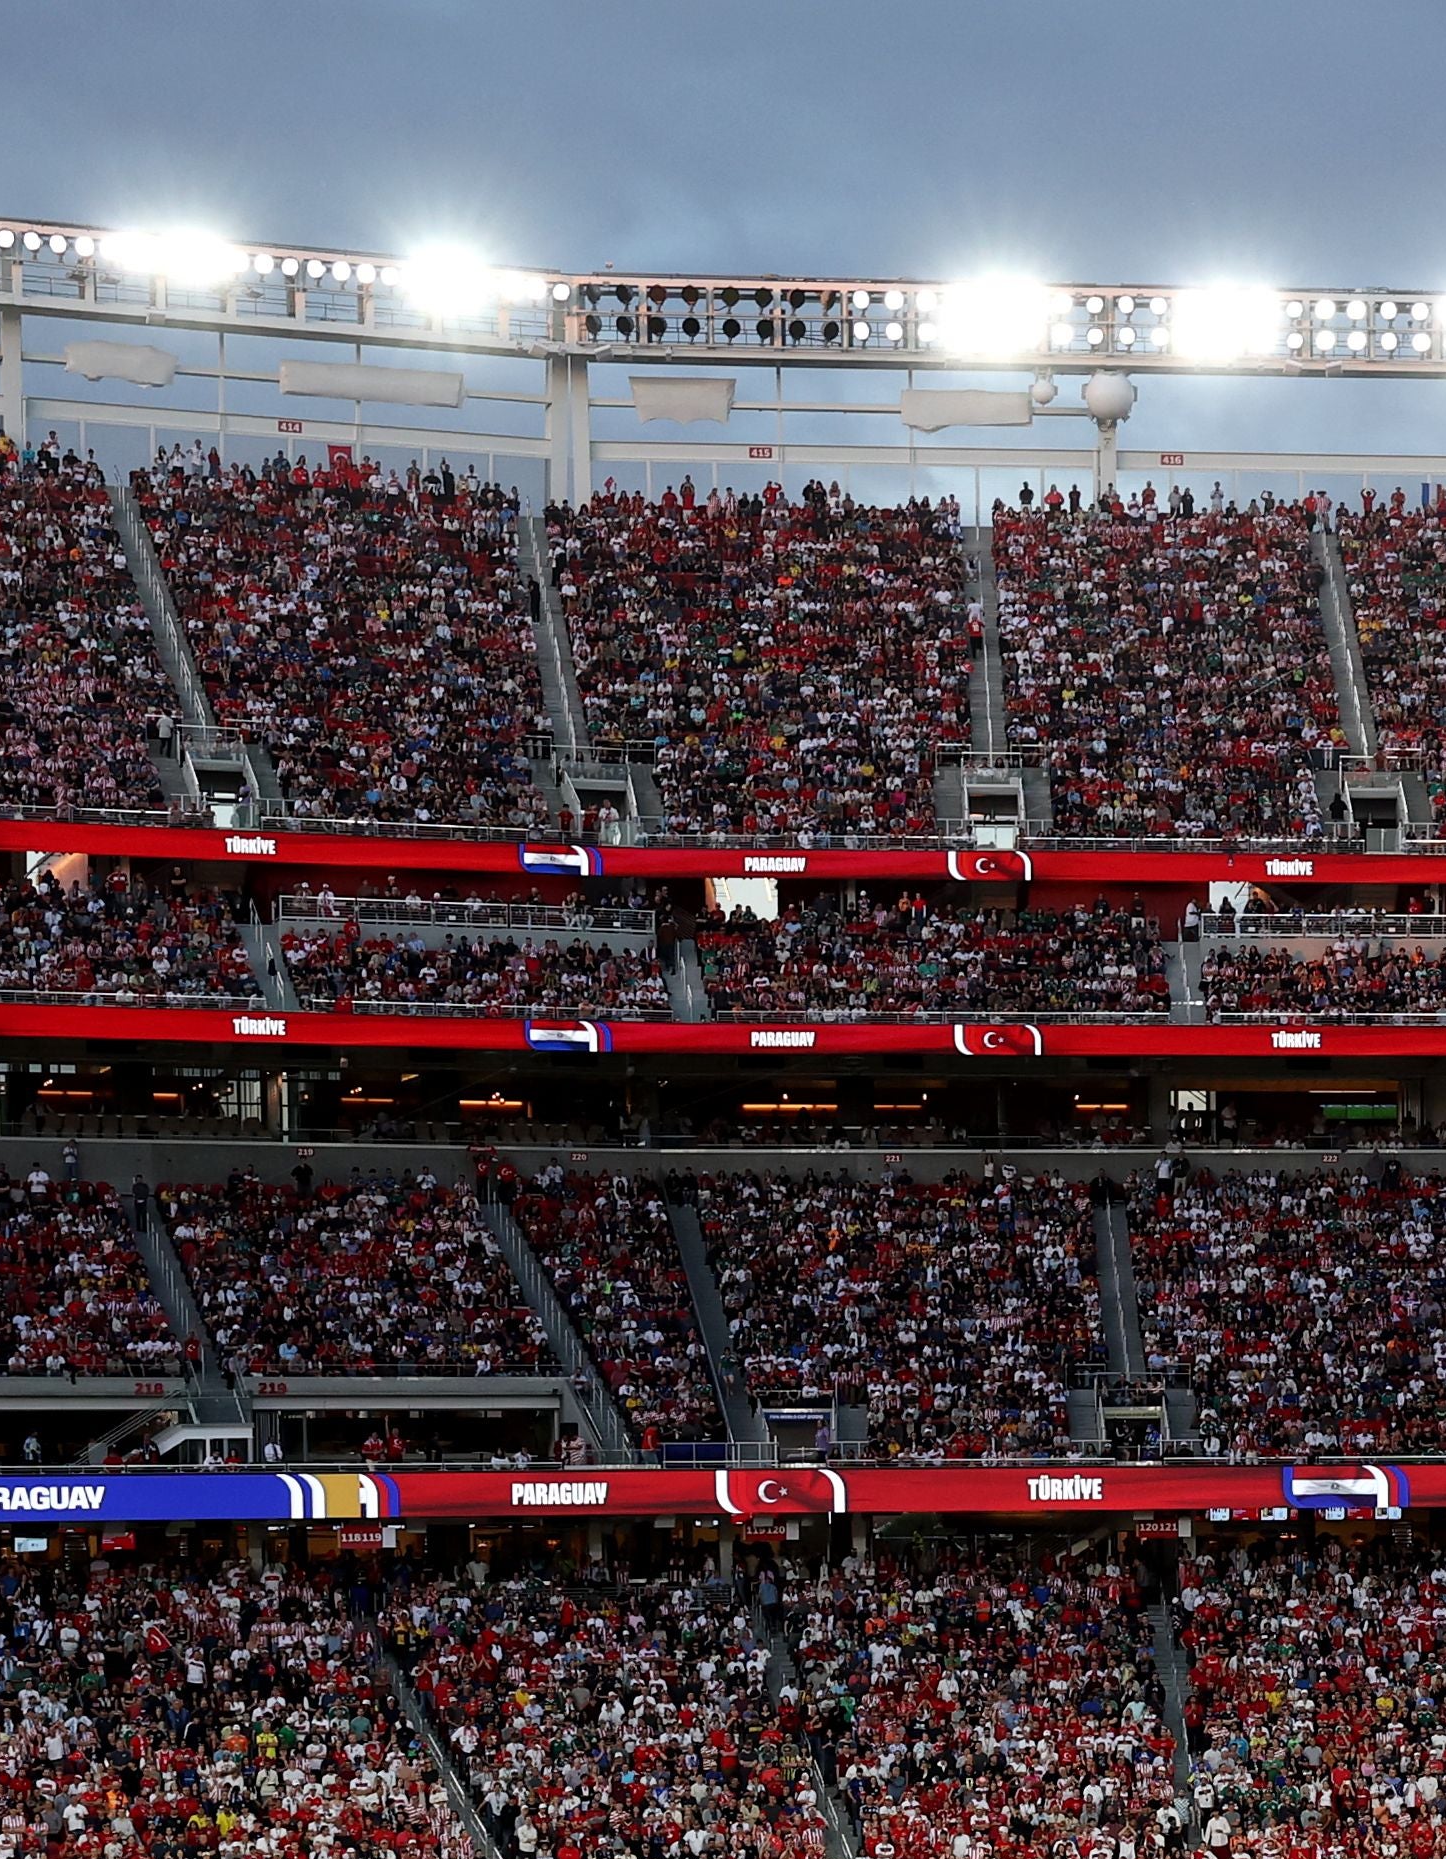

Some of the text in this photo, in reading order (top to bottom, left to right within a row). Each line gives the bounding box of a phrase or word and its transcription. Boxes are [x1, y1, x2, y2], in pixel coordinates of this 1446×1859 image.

[280, 422, 300, 432] 414
[751, 449, 770, 457] 415
[1162, 456, 1181, 464] 416
[225, 836, 275, 854] TÜRKİYE
[745, 857, 805, 872] PARAGUAY
[1266, 859, 1312, 875] TÜRKİYE
[233, 1016, 285, 1035] TÜRKİYE
[751, 1032, 815, 1046] PARAGUAY
[1272, 1031, 1320, 1048] TÜRKİYE
[572, 1153, 586, 1161] 220
[135, 1383, 163, 1395] 218
[258, 1382, 287, 1395] 219
[512, 1483, 607, 1505] PARAGUAY
[1028, 1475, 1102, 1500] TÜRKİYE
[768, 1526, 786, 1534] 120
[1140, 1523, 1177, 1532] 120 121
[341, 1533, 382, 1542] 118 119
